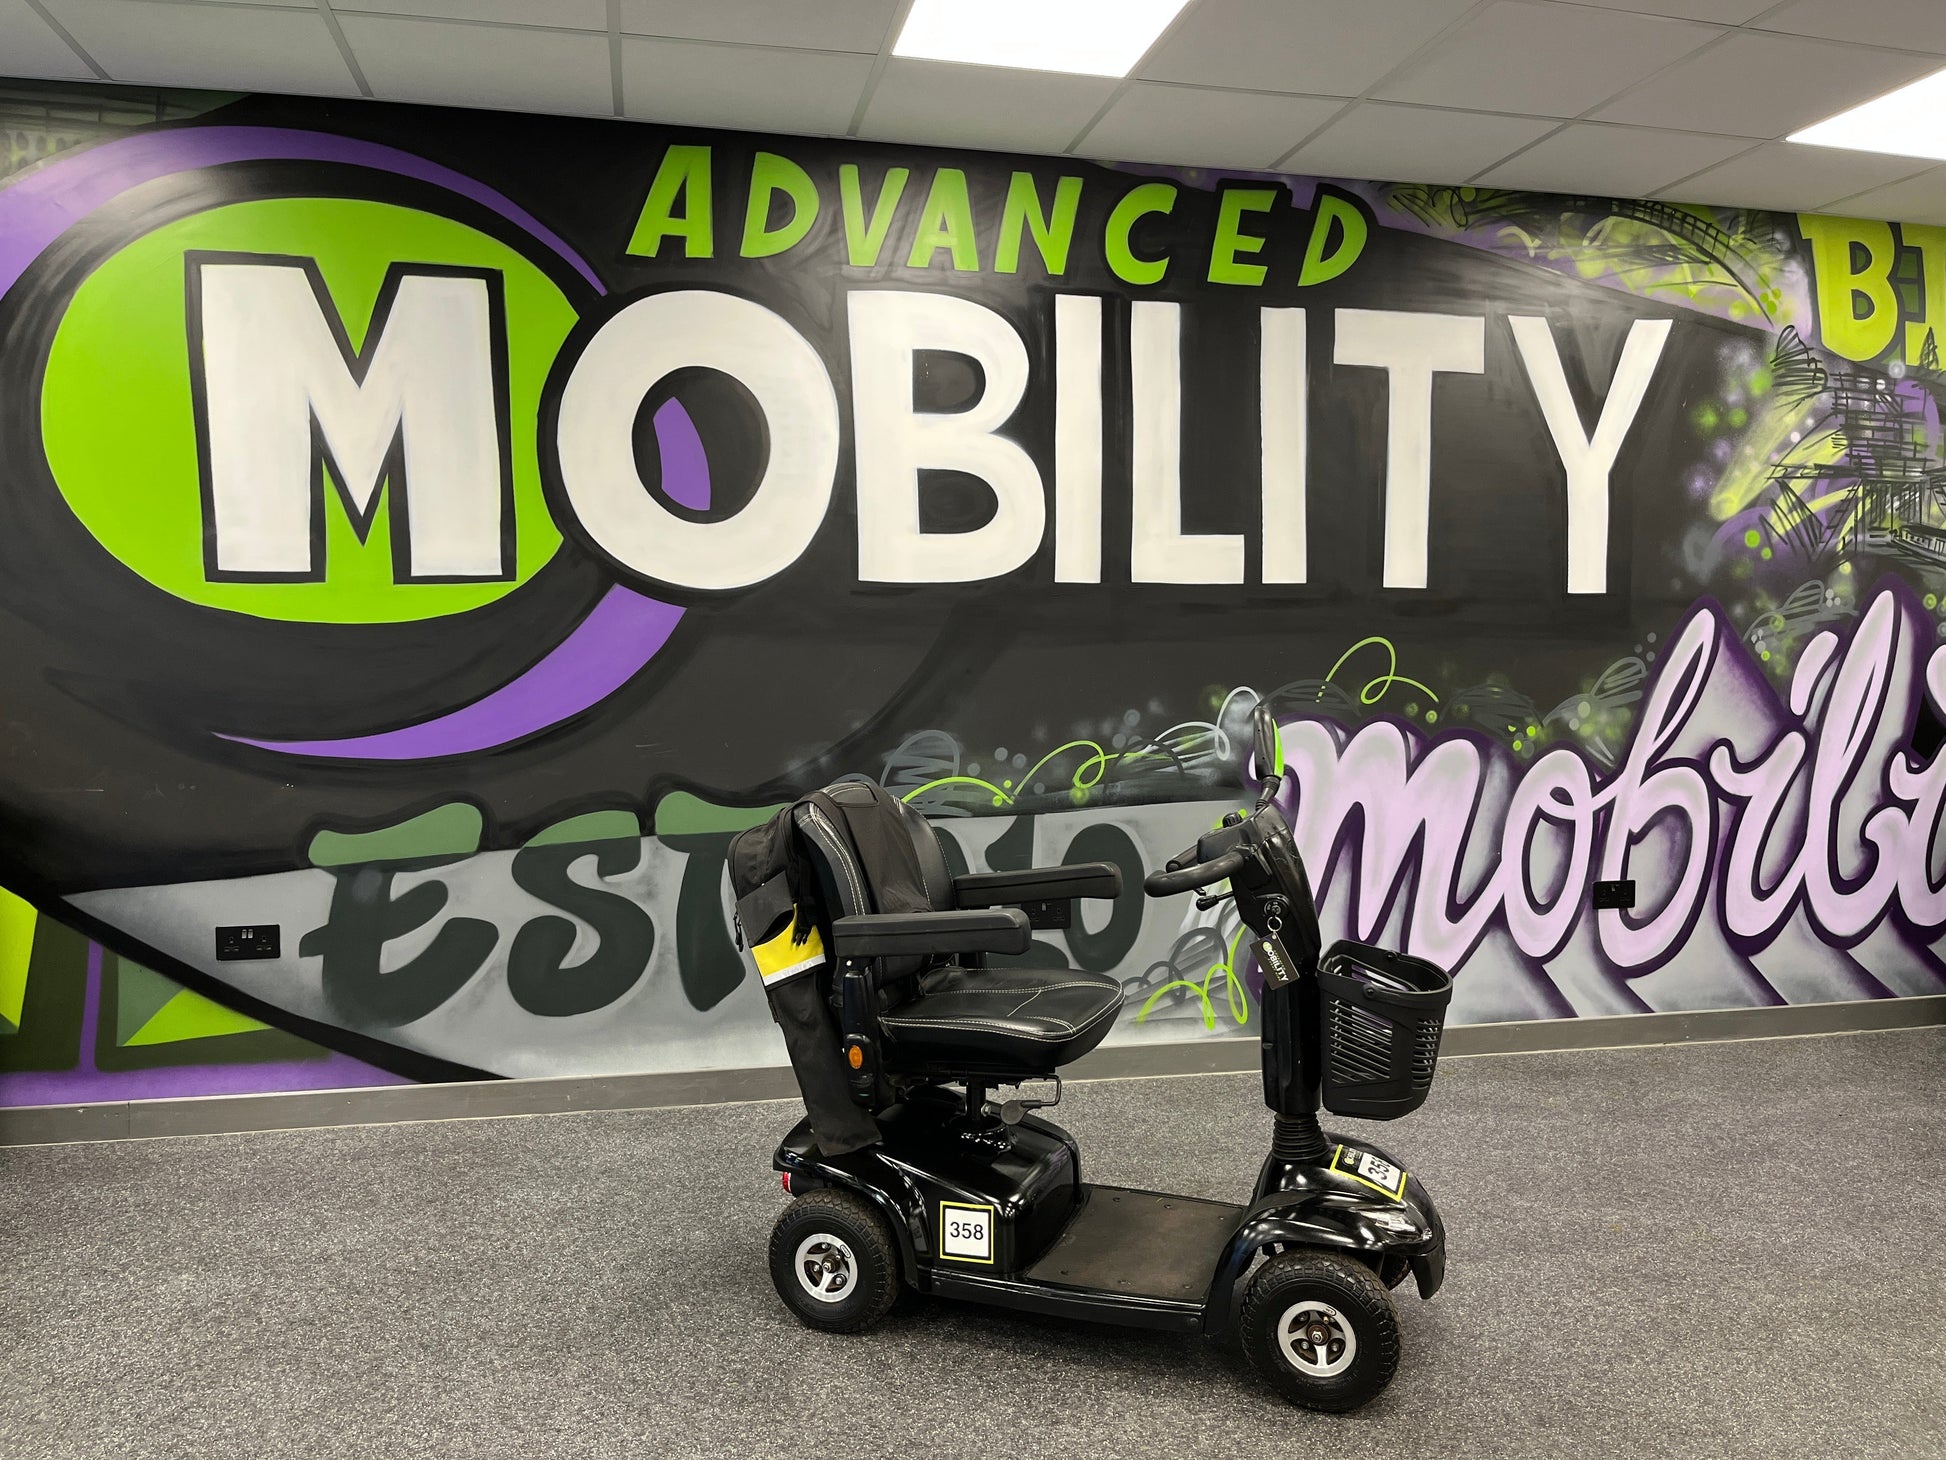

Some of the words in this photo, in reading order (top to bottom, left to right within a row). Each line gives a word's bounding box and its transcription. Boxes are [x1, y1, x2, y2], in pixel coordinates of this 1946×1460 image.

[625, 144, 1368, 287] ADVANCED
[200, 263, 1674, 594] MOBILITY
[299, 791, 790, 1028] EST
[950, 1221, 984, 1241] 358
